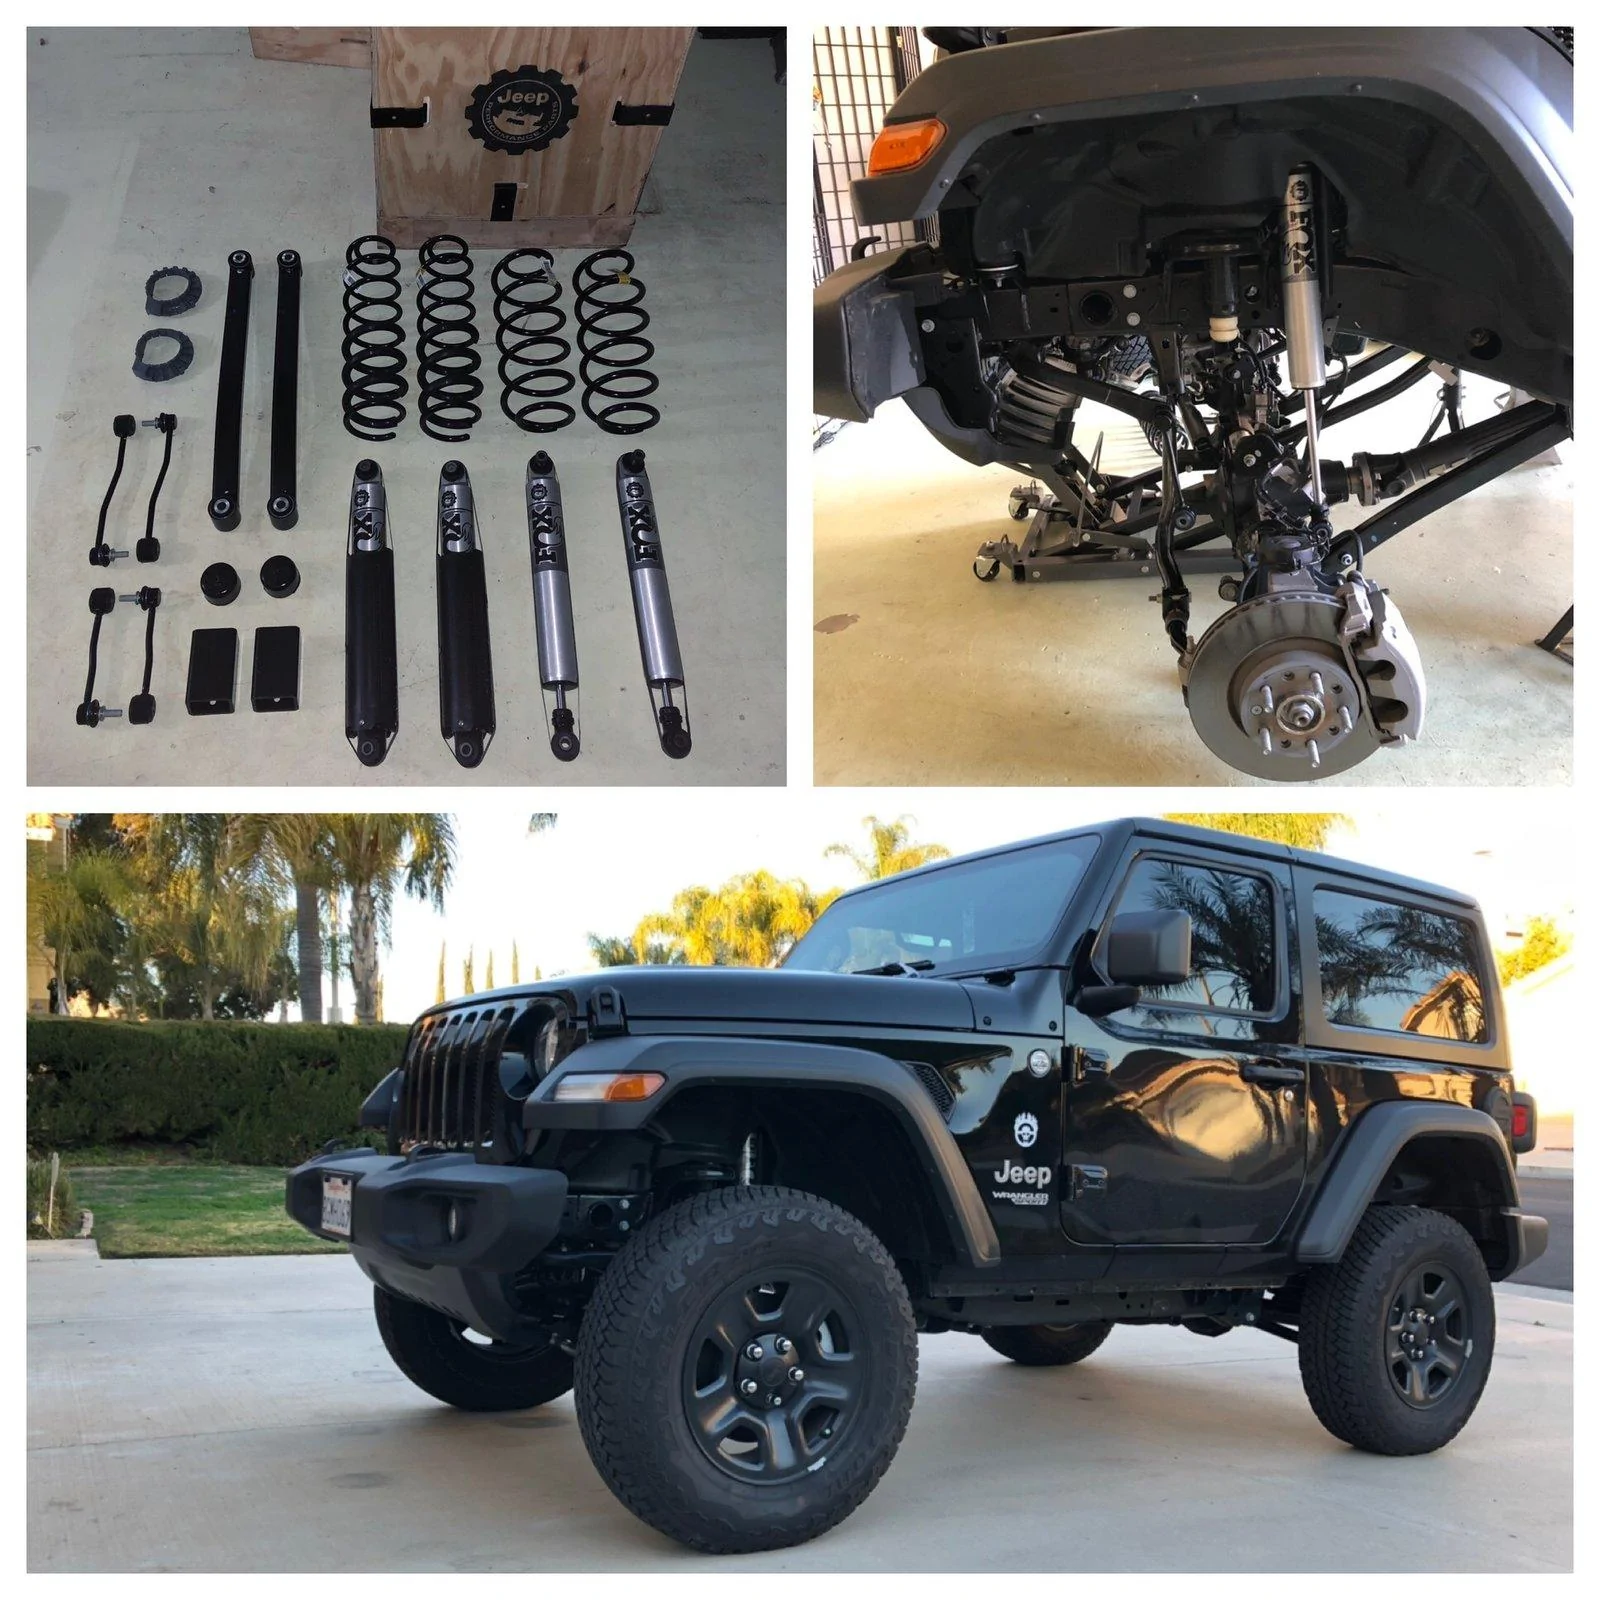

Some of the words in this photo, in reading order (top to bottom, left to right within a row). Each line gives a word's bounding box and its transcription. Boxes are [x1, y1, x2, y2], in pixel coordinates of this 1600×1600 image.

[497, 89, 550, 105] Jeep
[485, 101, 540, 141] PERFORMANCE
[542, 100, 559, 131] PARTS
[1282, 209, 1318, 274] FOX
[353, 512, 384, 552] OX
[442, 512, 474, 553] OX
[531, 505, 563, 565] FOX
[627, 505, 660, 564] FOX
[992, 1190, 1049, 1199] WRANGLER
[994, 1159, 1052, 1189] Jeep
